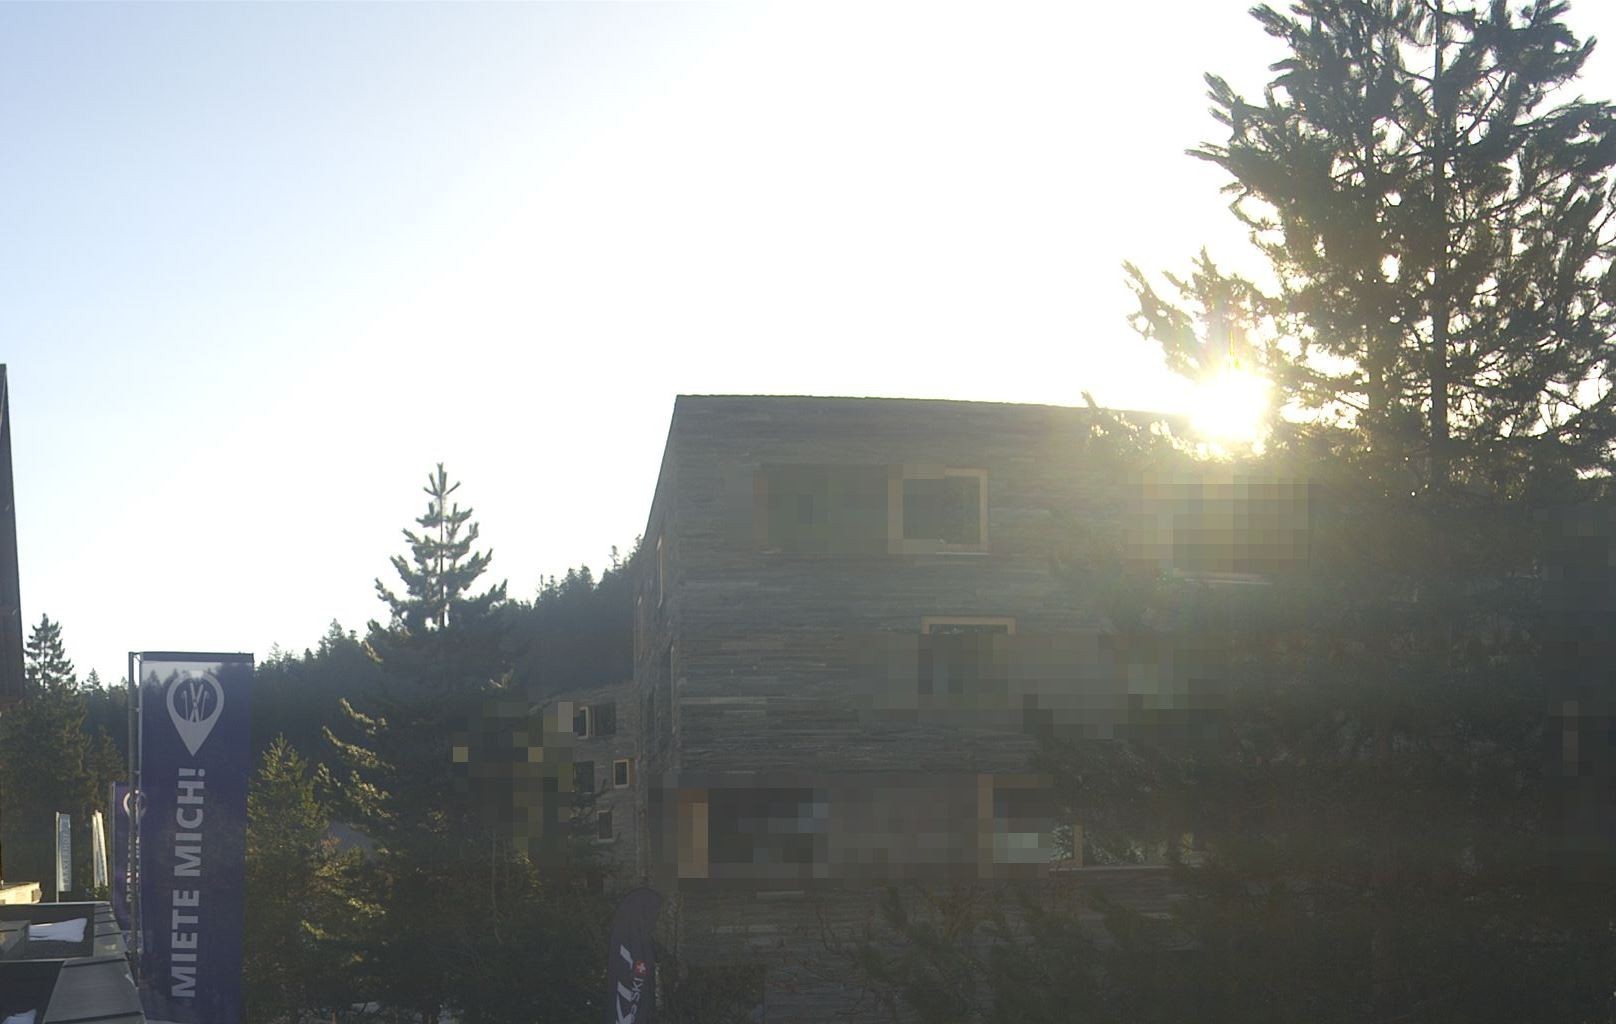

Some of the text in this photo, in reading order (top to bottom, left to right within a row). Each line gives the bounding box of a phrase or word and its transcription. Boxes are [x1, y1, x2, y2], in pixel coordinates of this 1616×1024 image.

[171, 767, 206, 998] MIETE MICH!
[631, 977, 644, 1001] SKI
